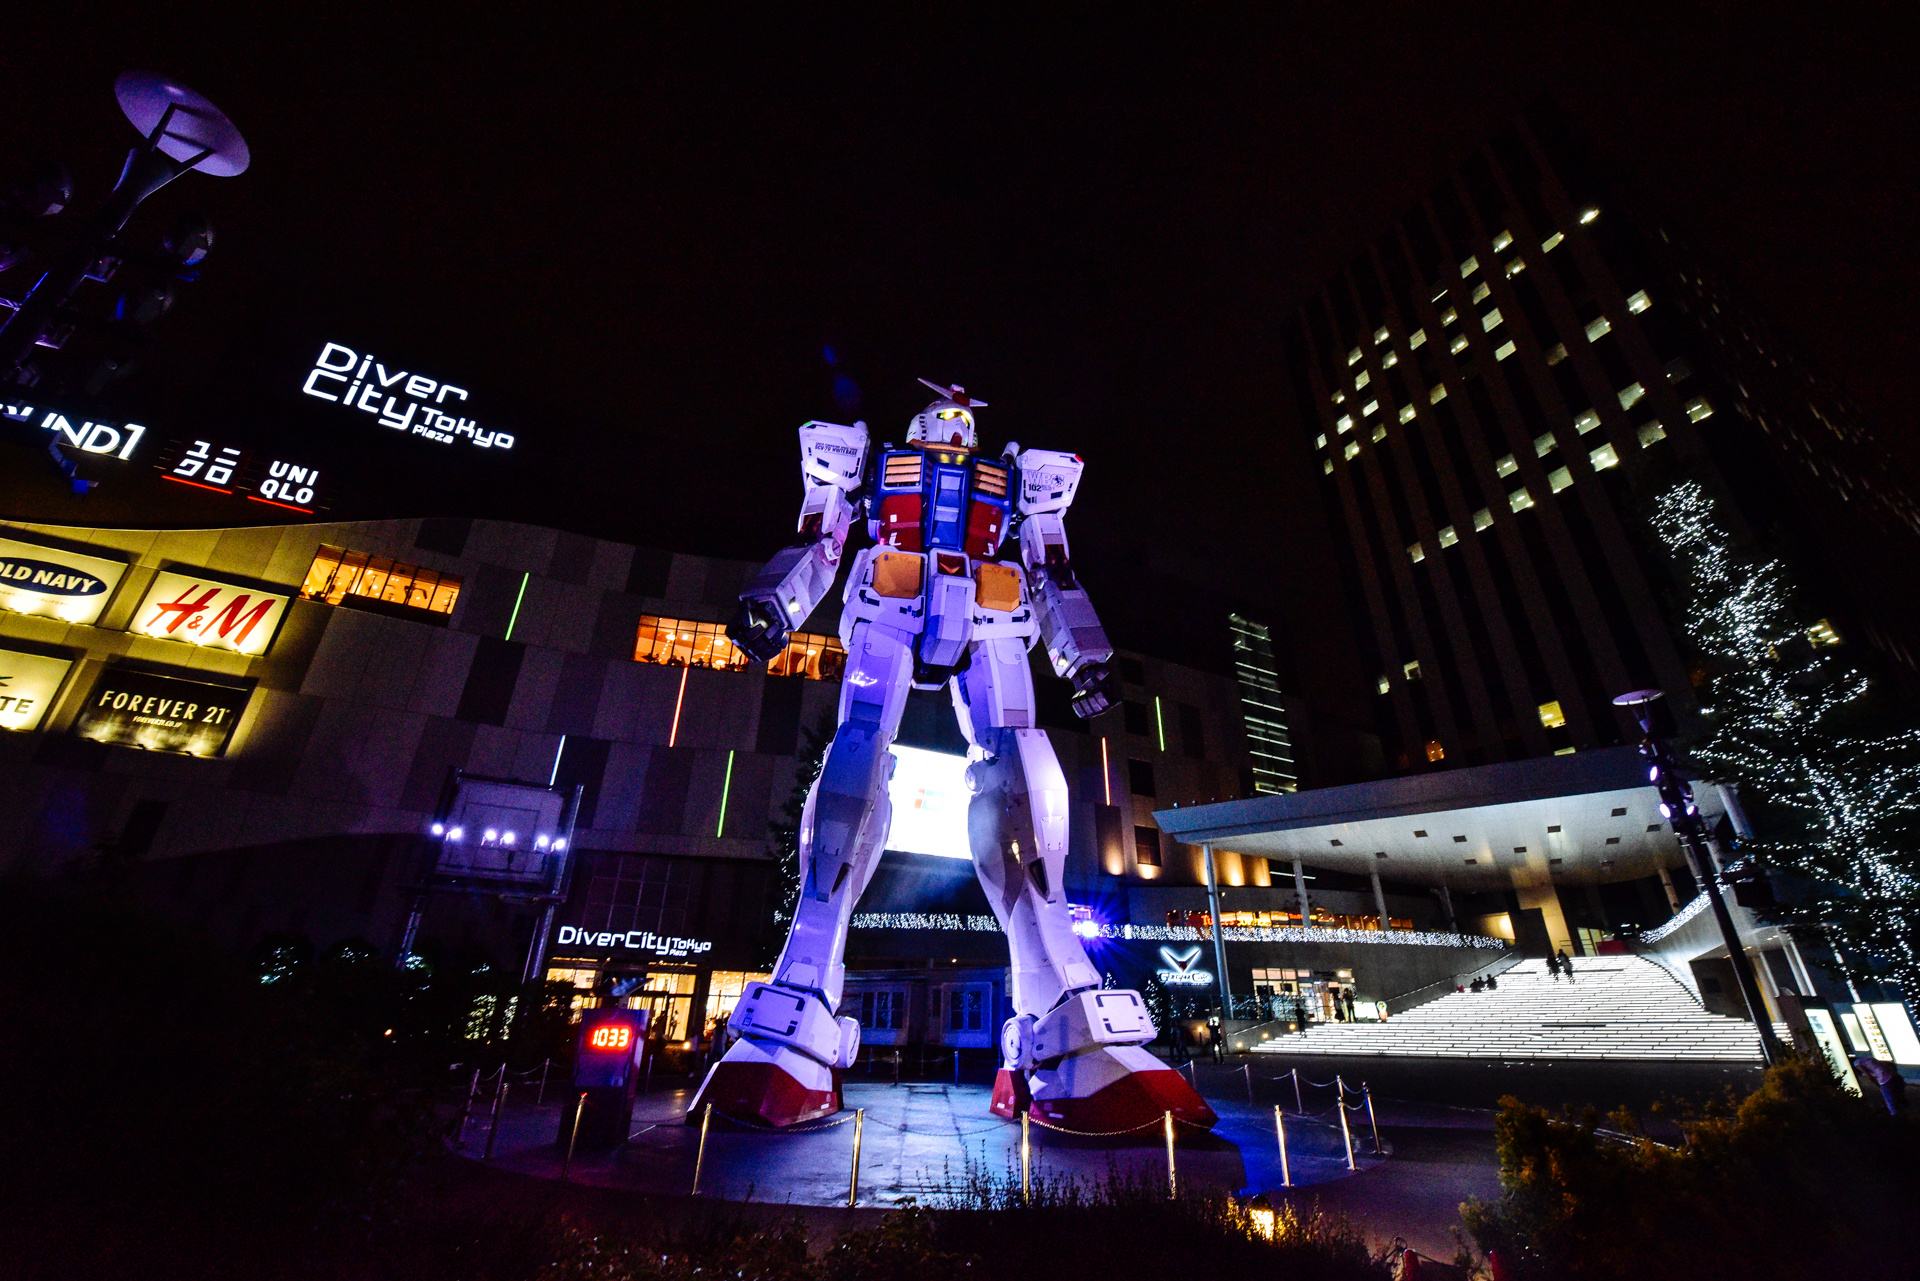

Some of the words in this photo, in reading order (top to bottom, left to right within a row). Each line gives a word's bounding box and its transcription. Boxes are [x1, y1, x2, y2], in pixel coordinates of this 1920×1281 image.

[315, 341, 469, 404] Diver
[302, 368, 418, 431] City
[421, 406, 515, 449] Tokyo
[412, 424, 454, 444] Plaza
[186, 440, 241, 467] ユニ
[173, 458, 233, 485] クロ
[269, 460, 319, 486] UNI
[259, 479, 314, 504] QLO
[1028, 484, 1042, 492] 102
[32, 570, 98, 593] NAVY
[146, 584, 277, 646] H&M
[99, 690, 198, 720] FOREVER
[557, 925, 671, 955] DiverCity
